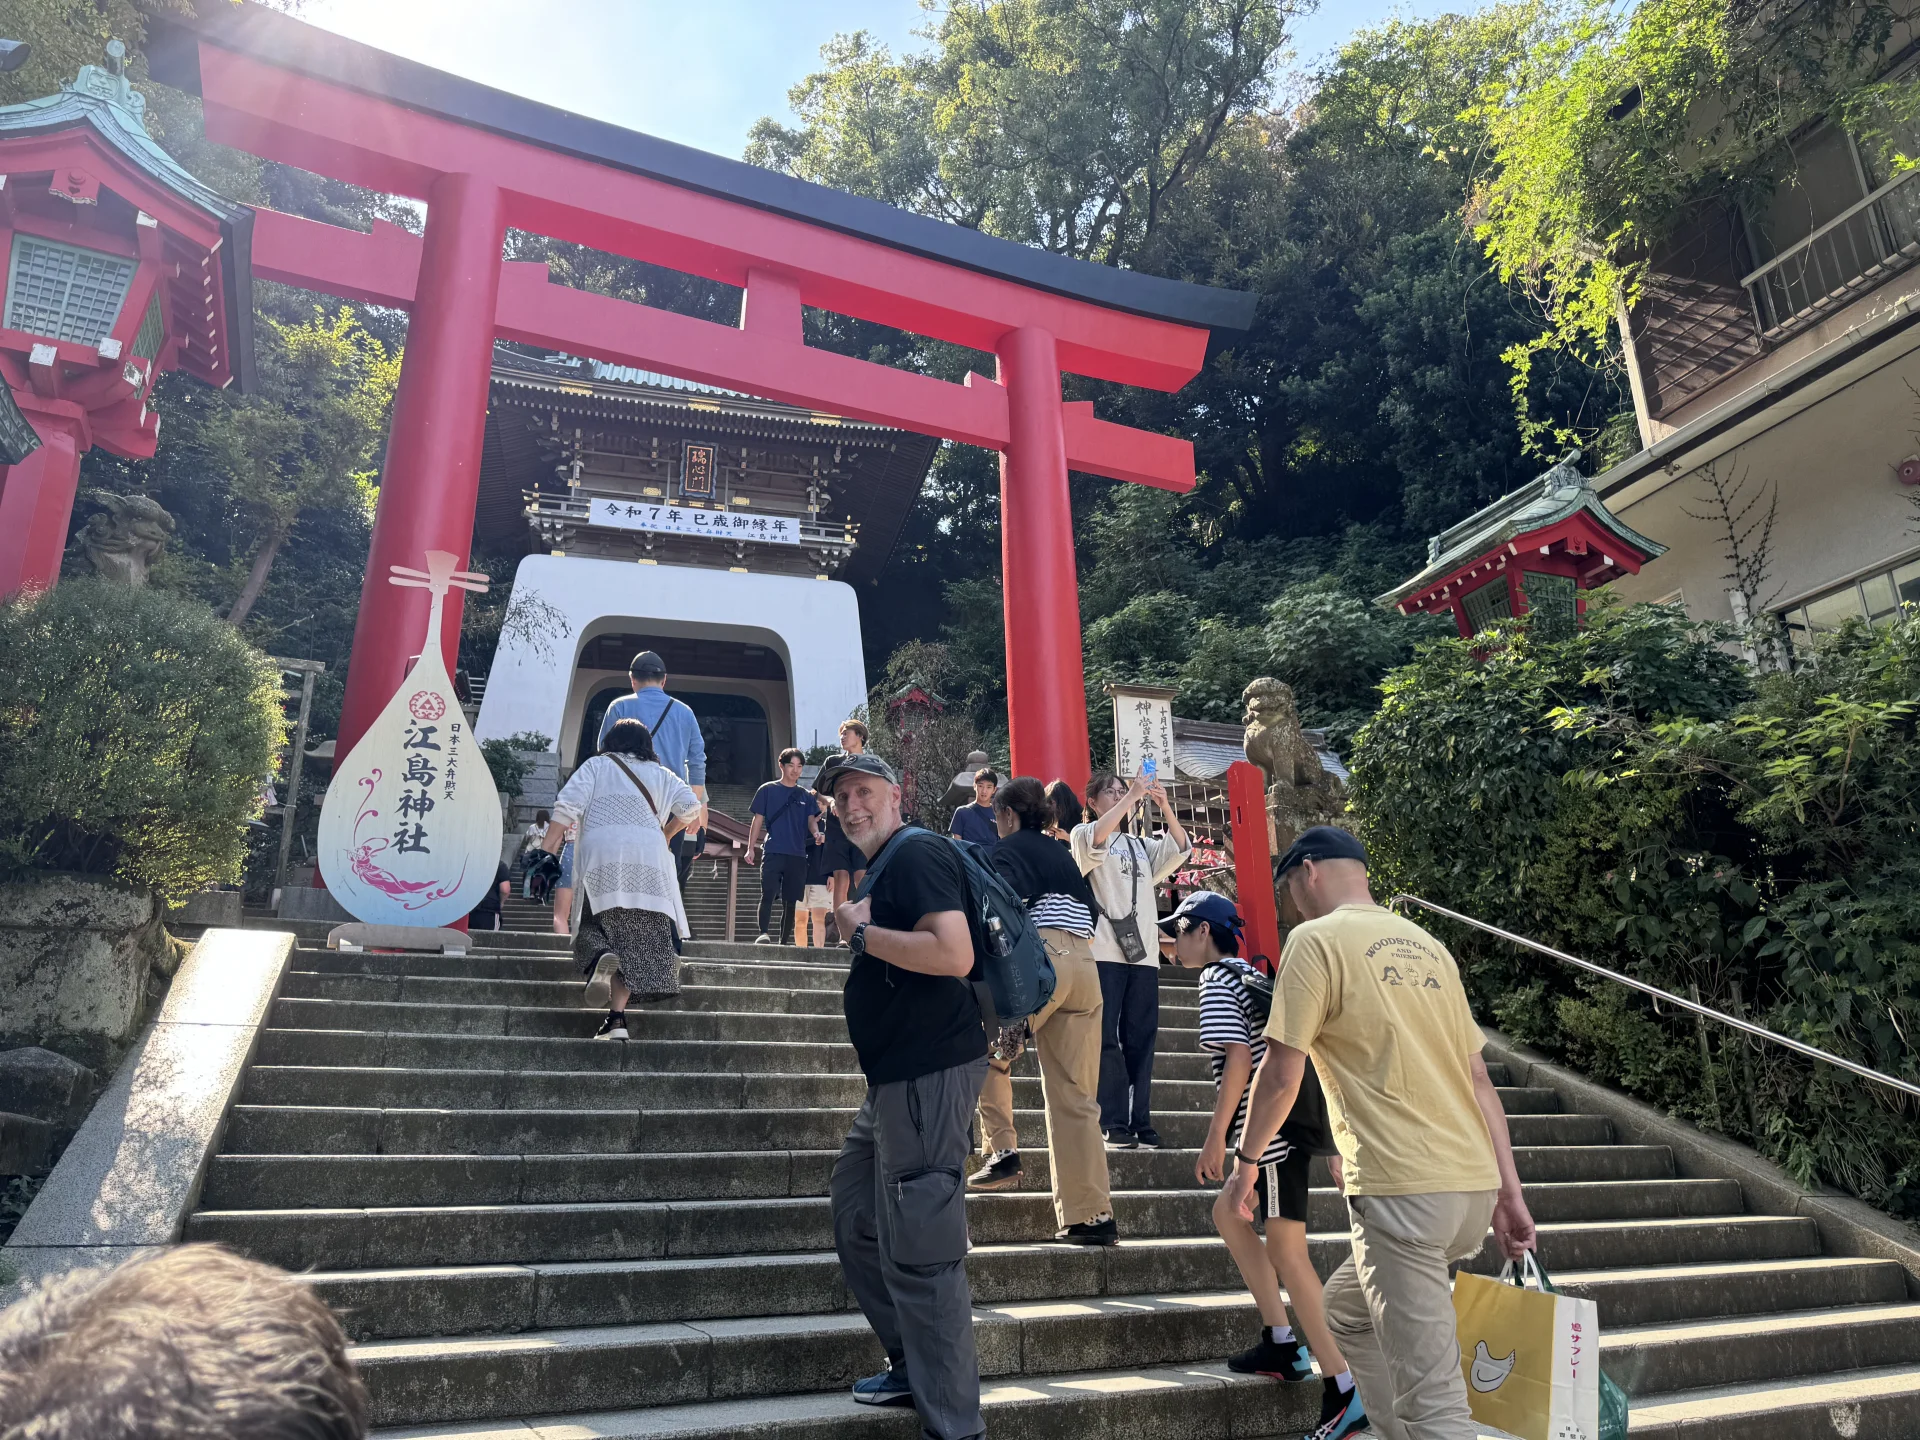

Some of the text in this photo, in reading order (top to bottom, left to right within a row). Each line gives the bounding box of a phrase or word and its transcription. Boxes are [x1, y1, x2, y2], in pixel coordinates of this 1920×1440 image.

[691, 449, 707, 490] 瑞心門
[604, 502, 789, 533] 令和7年 巳歳御縁年
[747, 532, 789, 542] 江島神社
[1120, 737, 1133, 775] 江島神社
[1159, 706, 1172, 768] 十月十七日十時
[443, 723, 461, 801] 日本三大弁財天
[390, 719, 441, 854] 江島神社
[1365, 937, 1440, 965] WOODSTOCK
[1391, 952, 1422, 961] FRIENDS
